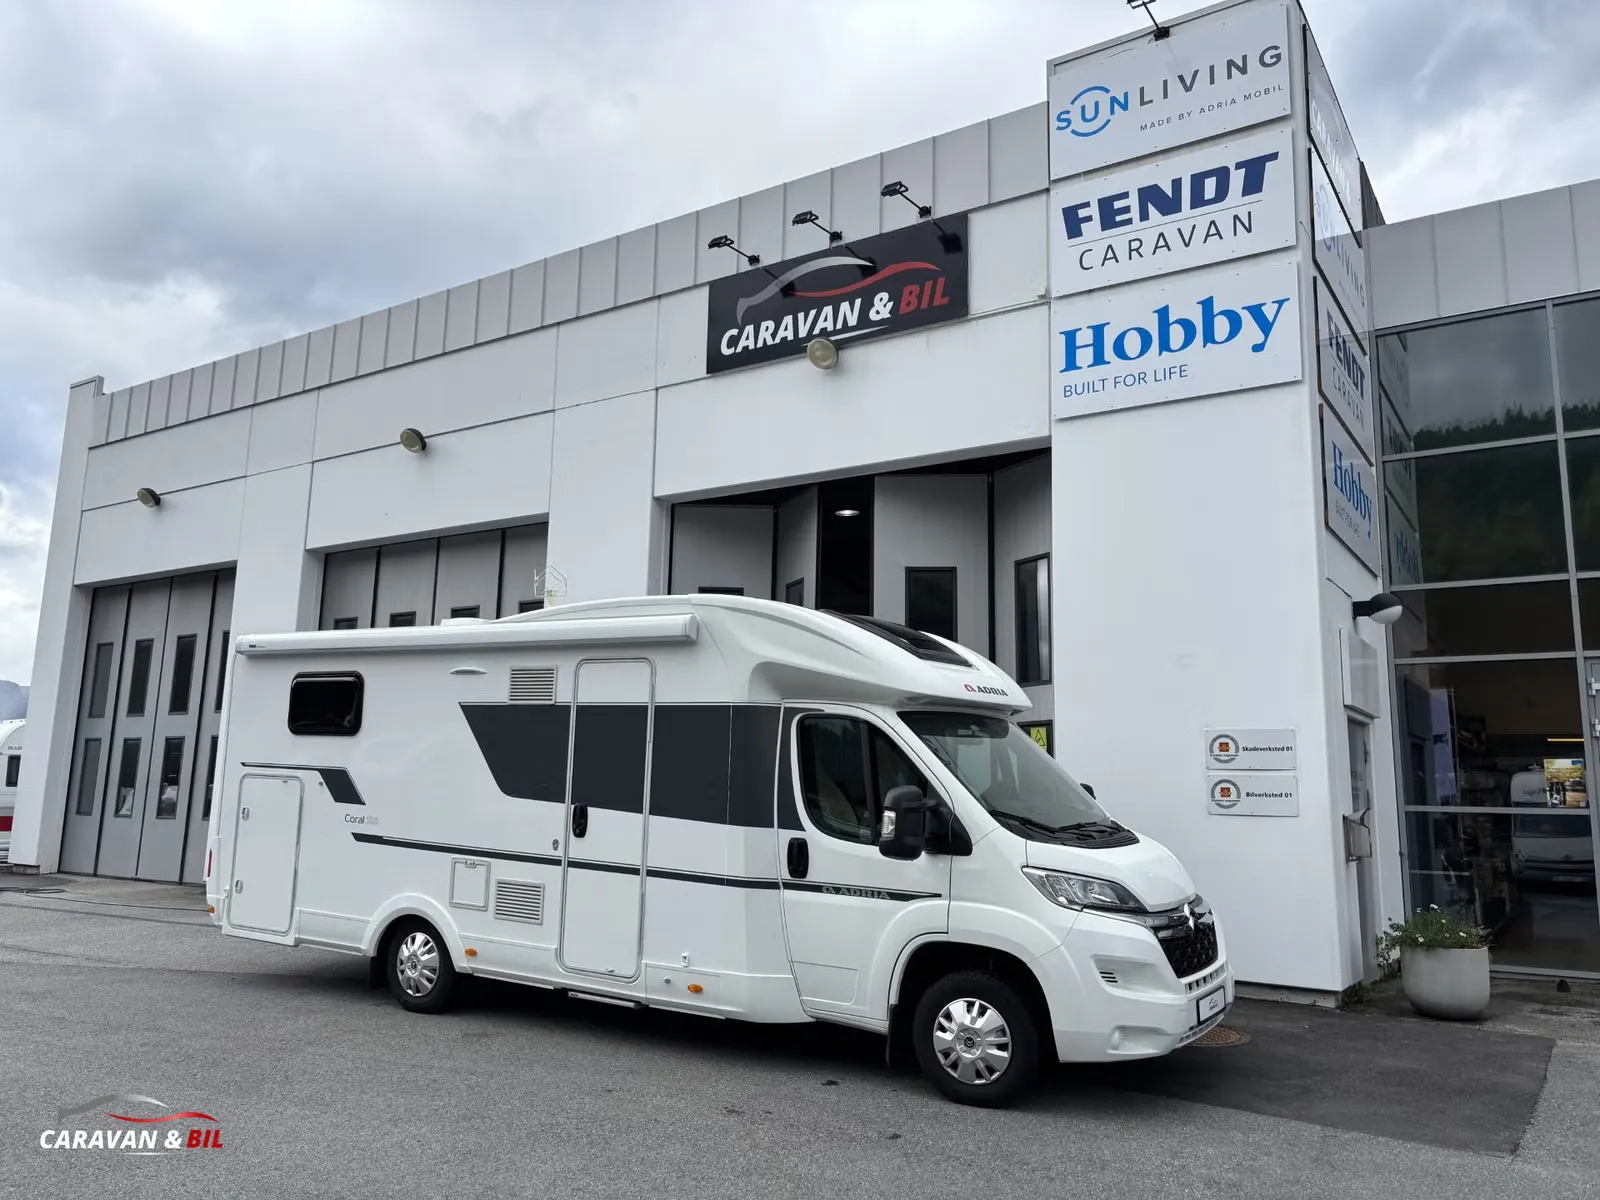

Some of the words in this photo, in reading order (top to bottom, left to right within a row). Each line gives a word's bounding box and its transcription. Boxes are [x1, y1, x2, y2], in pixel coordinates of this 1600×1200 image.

[1140, 116, 1172, 132] MADE
[1178, 110, 1193, 121] BY
[1199, 98, 1237, 114] ADRIA
[1243, 84, 1284, 101] MOBIL
[1062, 151, 1279, 240] FENDT
[1079, 211, 1252, 271] CARAVAN
[720, 298, 861, 356] CARAVAN
[868, 291, 894, 321] &
[898, 276, 950, 314] BIL
[1059, 295, 1290, 374] Hobby
[1063, 378, 1109, 398] BUILT
[1113, 371, 1148, 390] FOR
[1153, 364, 1189, 383] LIFE
[1327, 307, 1365, 401] FENDT
[1332, 439, 1373, 539] Hobby
[977, 685, 1009, 697] ADRIA
[344, 813, 365, 825] Coral
[1245, 791, 1283, 799] Bilverksted
[1284, 791, 1293, 799] 01
[840, 888, 891, 900] ADRIA
